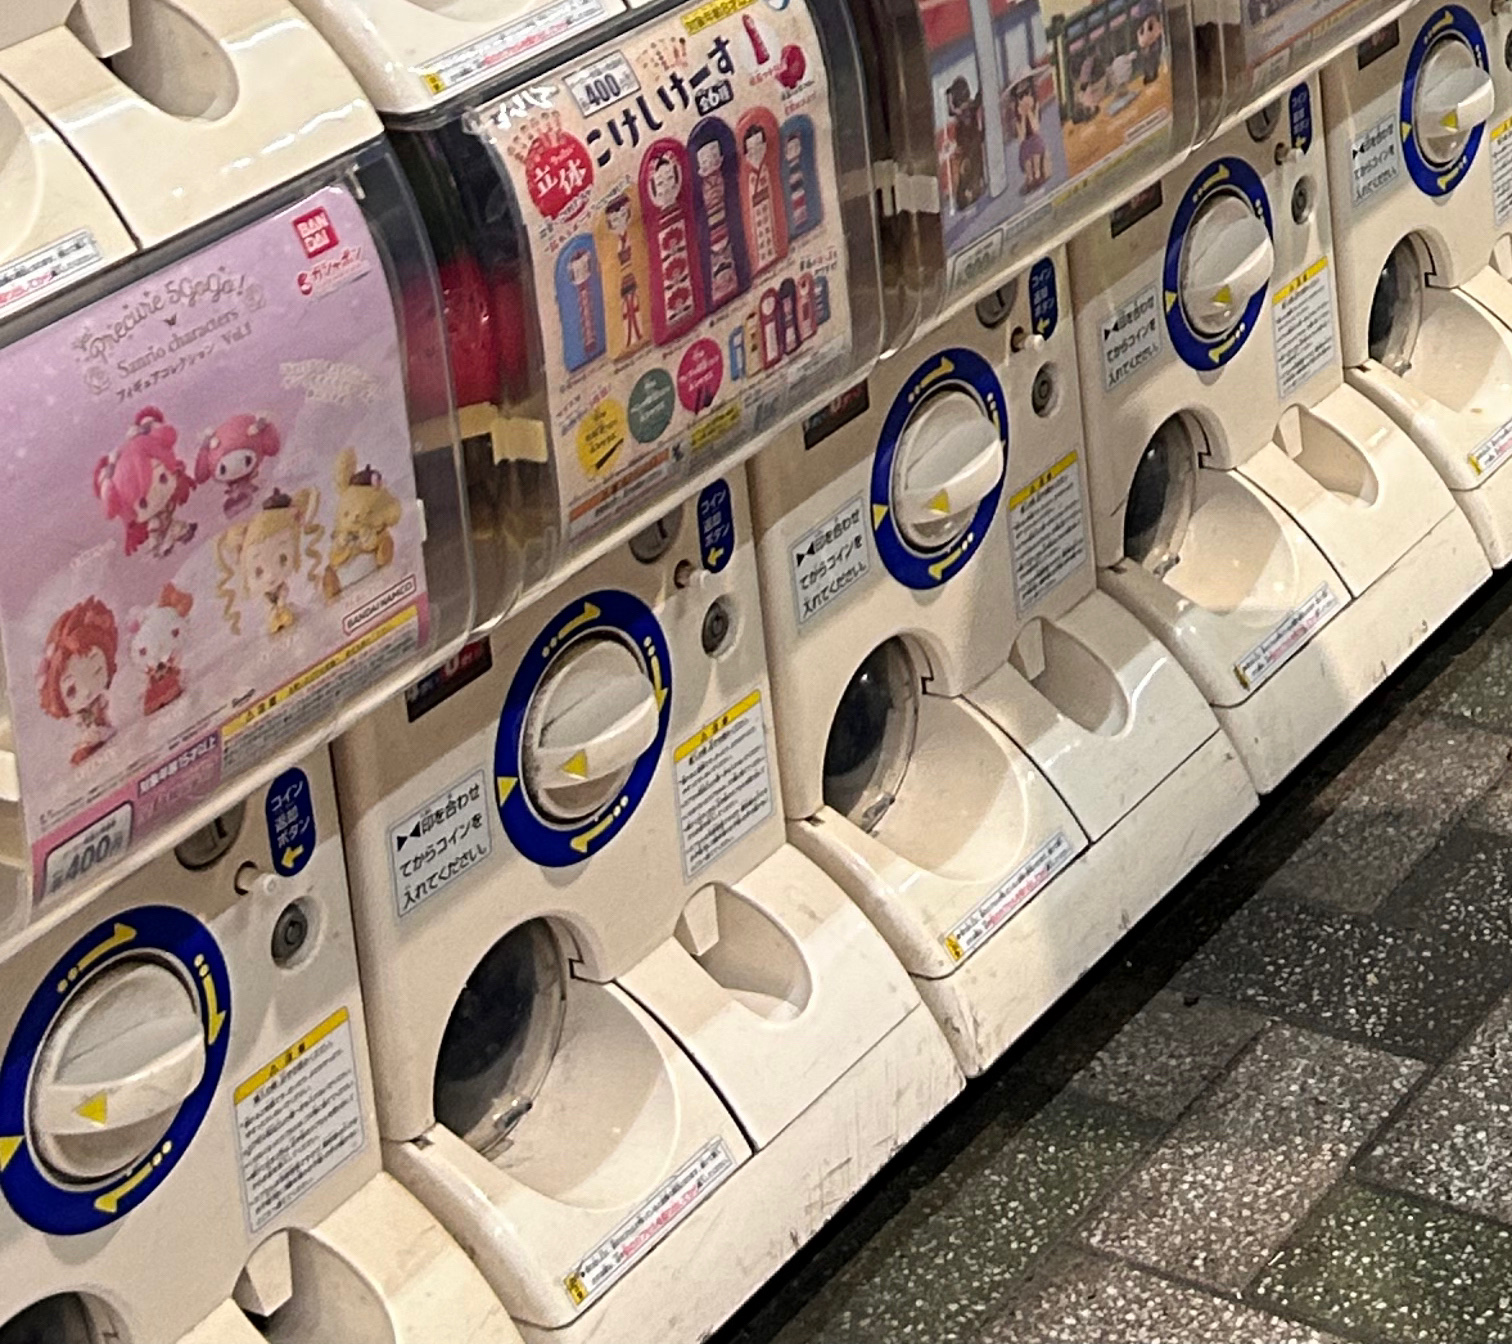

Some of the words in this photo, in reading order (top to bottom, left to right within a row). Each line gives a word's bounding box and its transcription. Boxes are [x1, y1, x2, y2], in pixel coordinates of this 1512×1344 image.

[586, 34, 735, 169] こけしけーす
[298, 212, 328, 238] BAN
[305, 231, 331, 254] DAI
[116, 340, 166, 378] Sanrio
[167, 310, 239, 358] characters
[800, 535, 862, 589] てからコインを
[345, 600, 383, 629] BANDAI
[382, 582, 415, 612] NAMCO
[271, 780, 304, 810] コイン
[421, 783, 481, 836] 印を合わせ
[277, 816, 311, 849] ボタン
[399, 819, 484, 885] てからコインを
[403, 844, 488, 912] 入れてください
